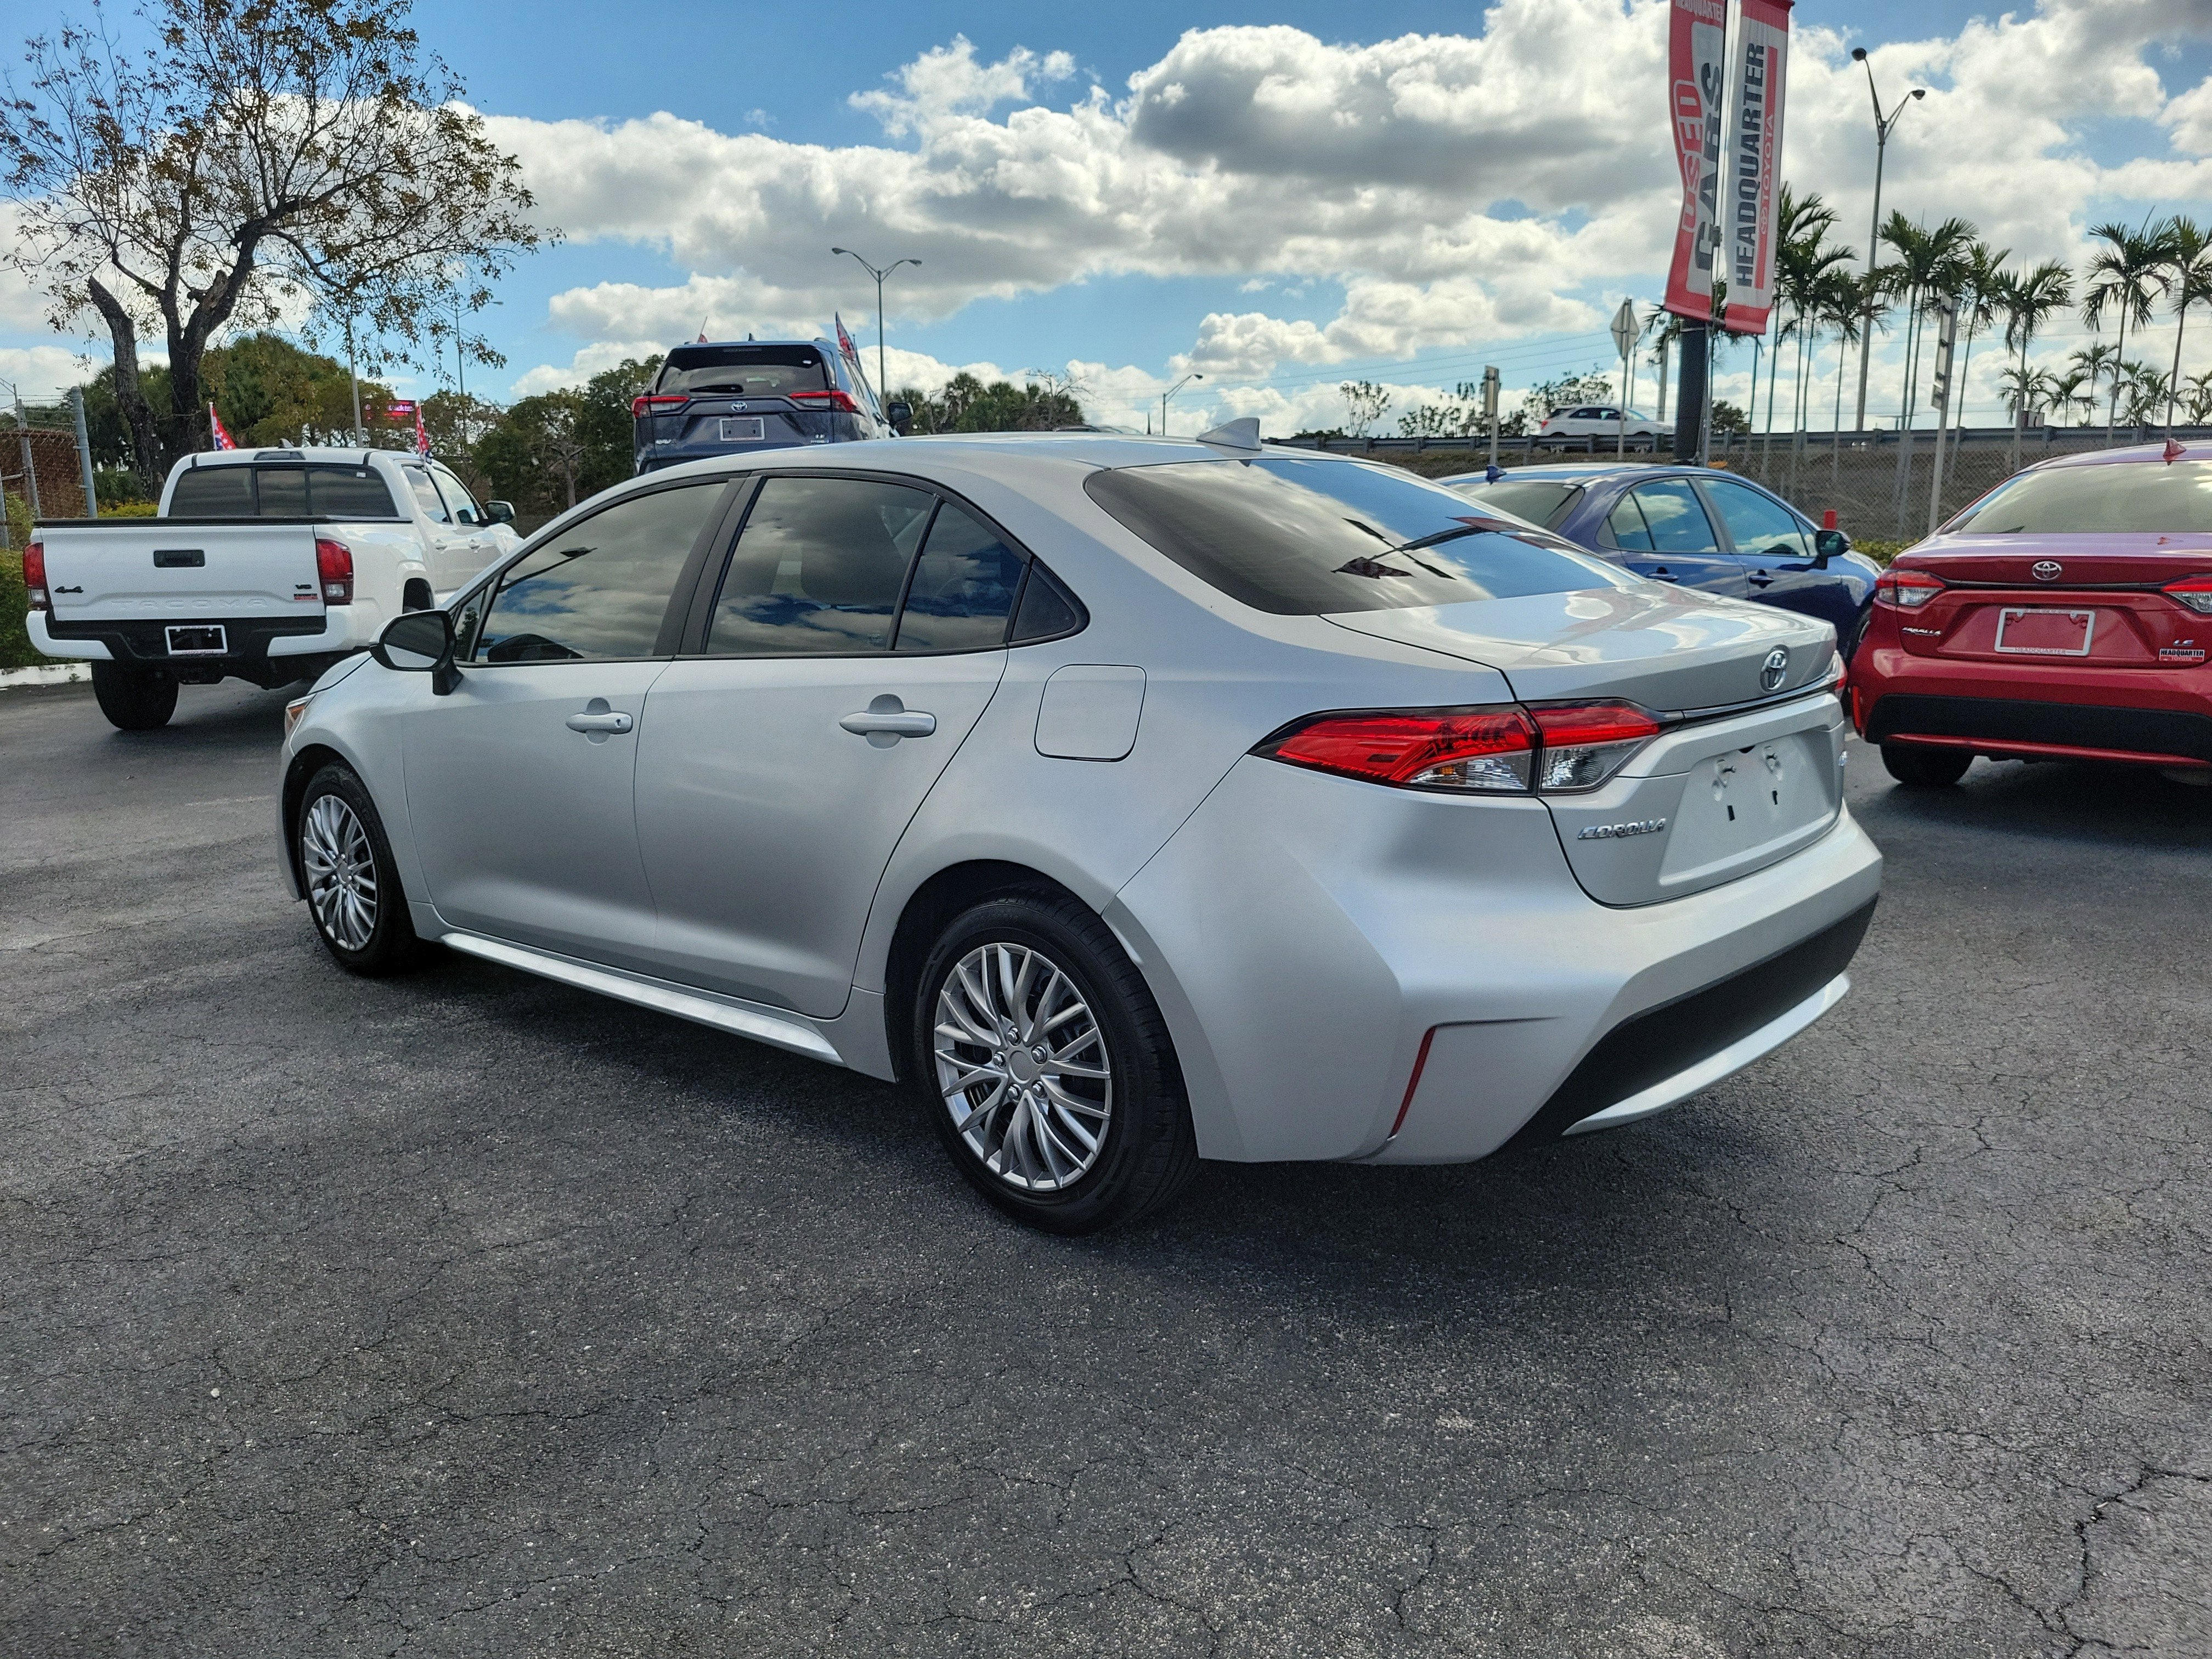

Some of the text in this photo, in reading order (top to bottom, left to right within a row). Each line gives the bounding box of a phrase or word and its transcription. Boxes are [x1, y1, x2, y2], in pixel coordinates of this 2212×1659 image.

[1675, 81, 1703, 232] USED
[1695, 63, 1720, 271] CARS
[1735, 43, 1764, 287] HEADQUARTER
[1761, 114, 1775, 201] TOYOTA
[1578, 818, 1666, 840] COROLLA
